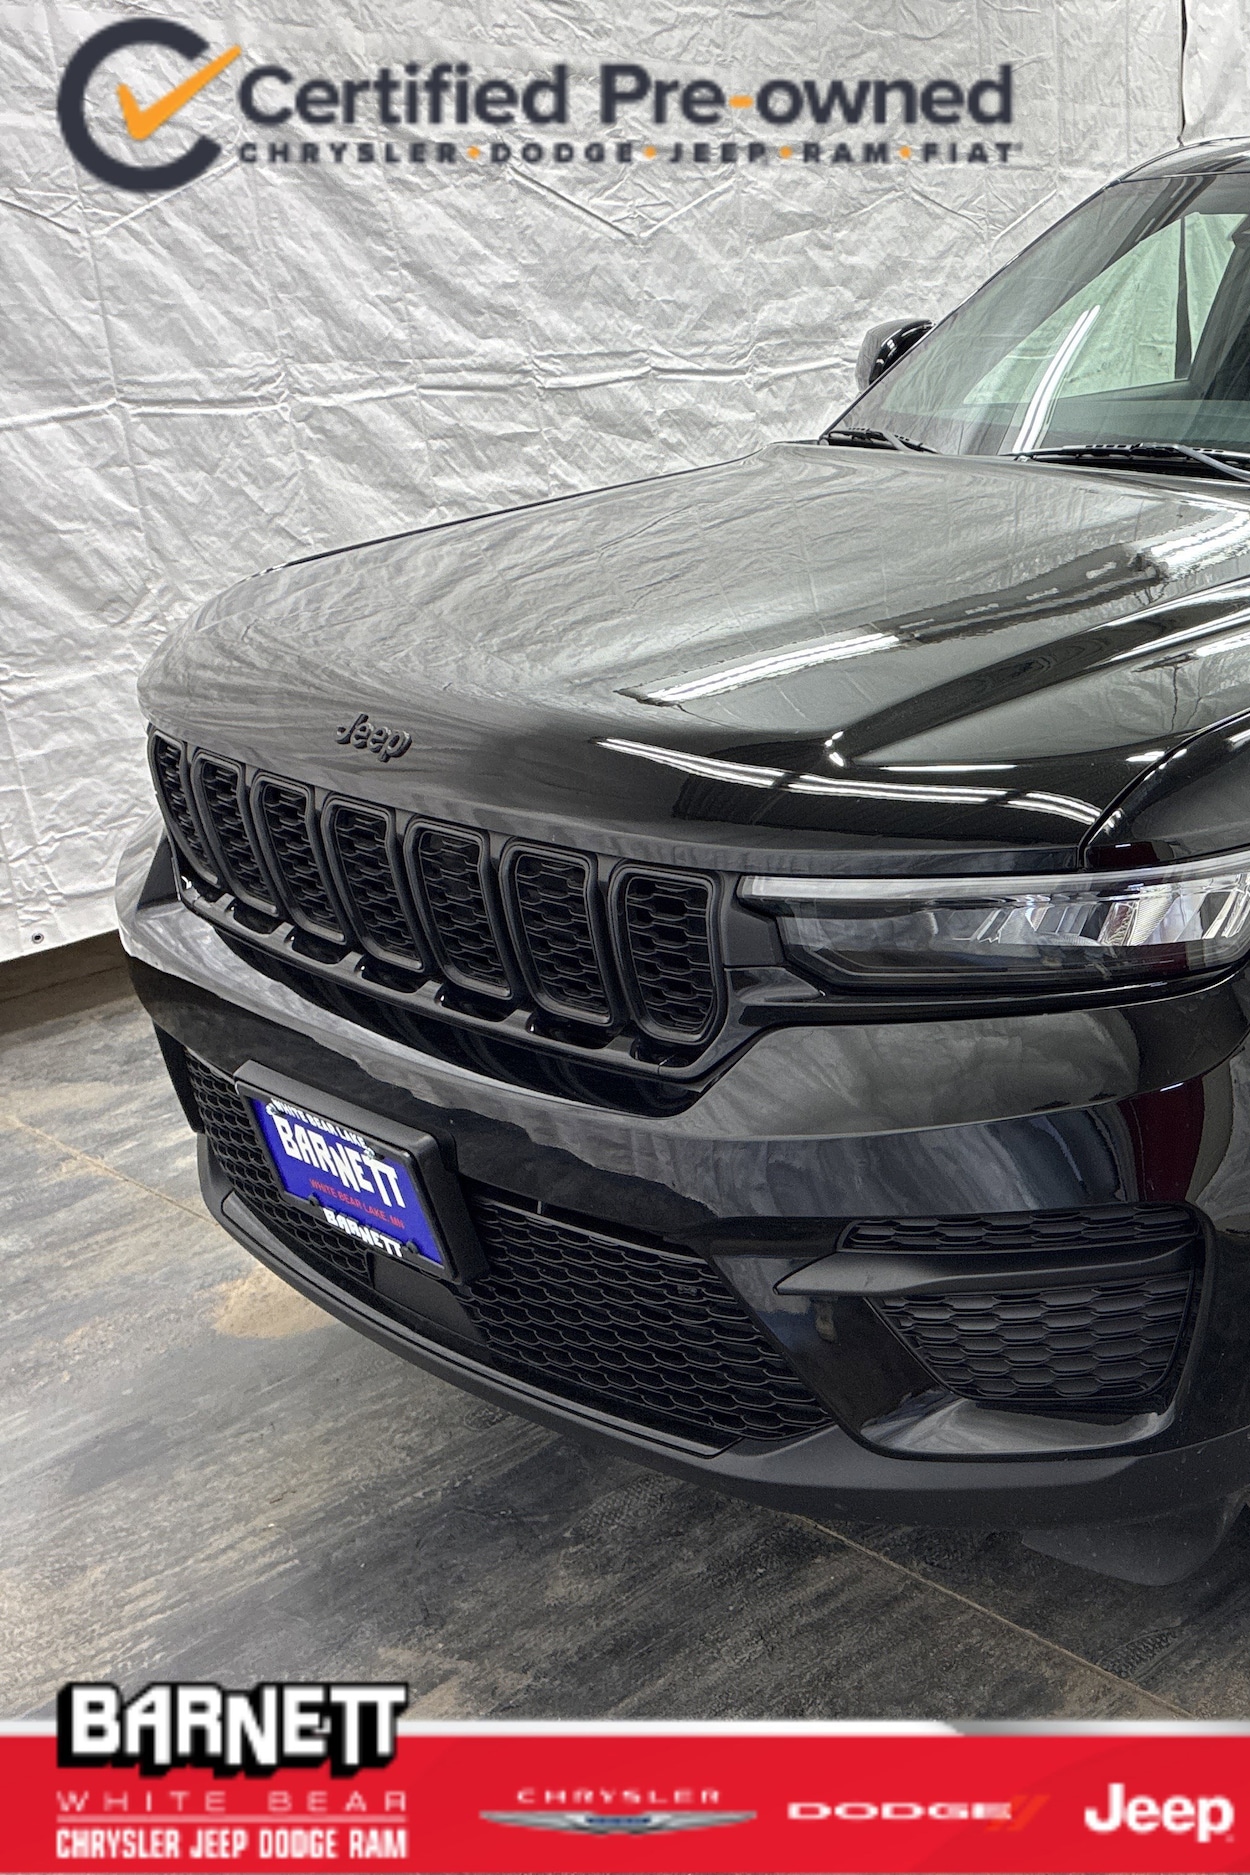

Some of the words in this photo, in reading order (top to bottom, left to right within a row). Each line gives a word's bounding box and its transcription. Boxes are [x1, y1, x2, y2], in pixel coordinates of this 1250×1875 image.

[335, 713, 412, 763] Jeep
[271, 1114, 406, 1208] BARNETT
[322, 1207, 402, 1258] BARNETT
